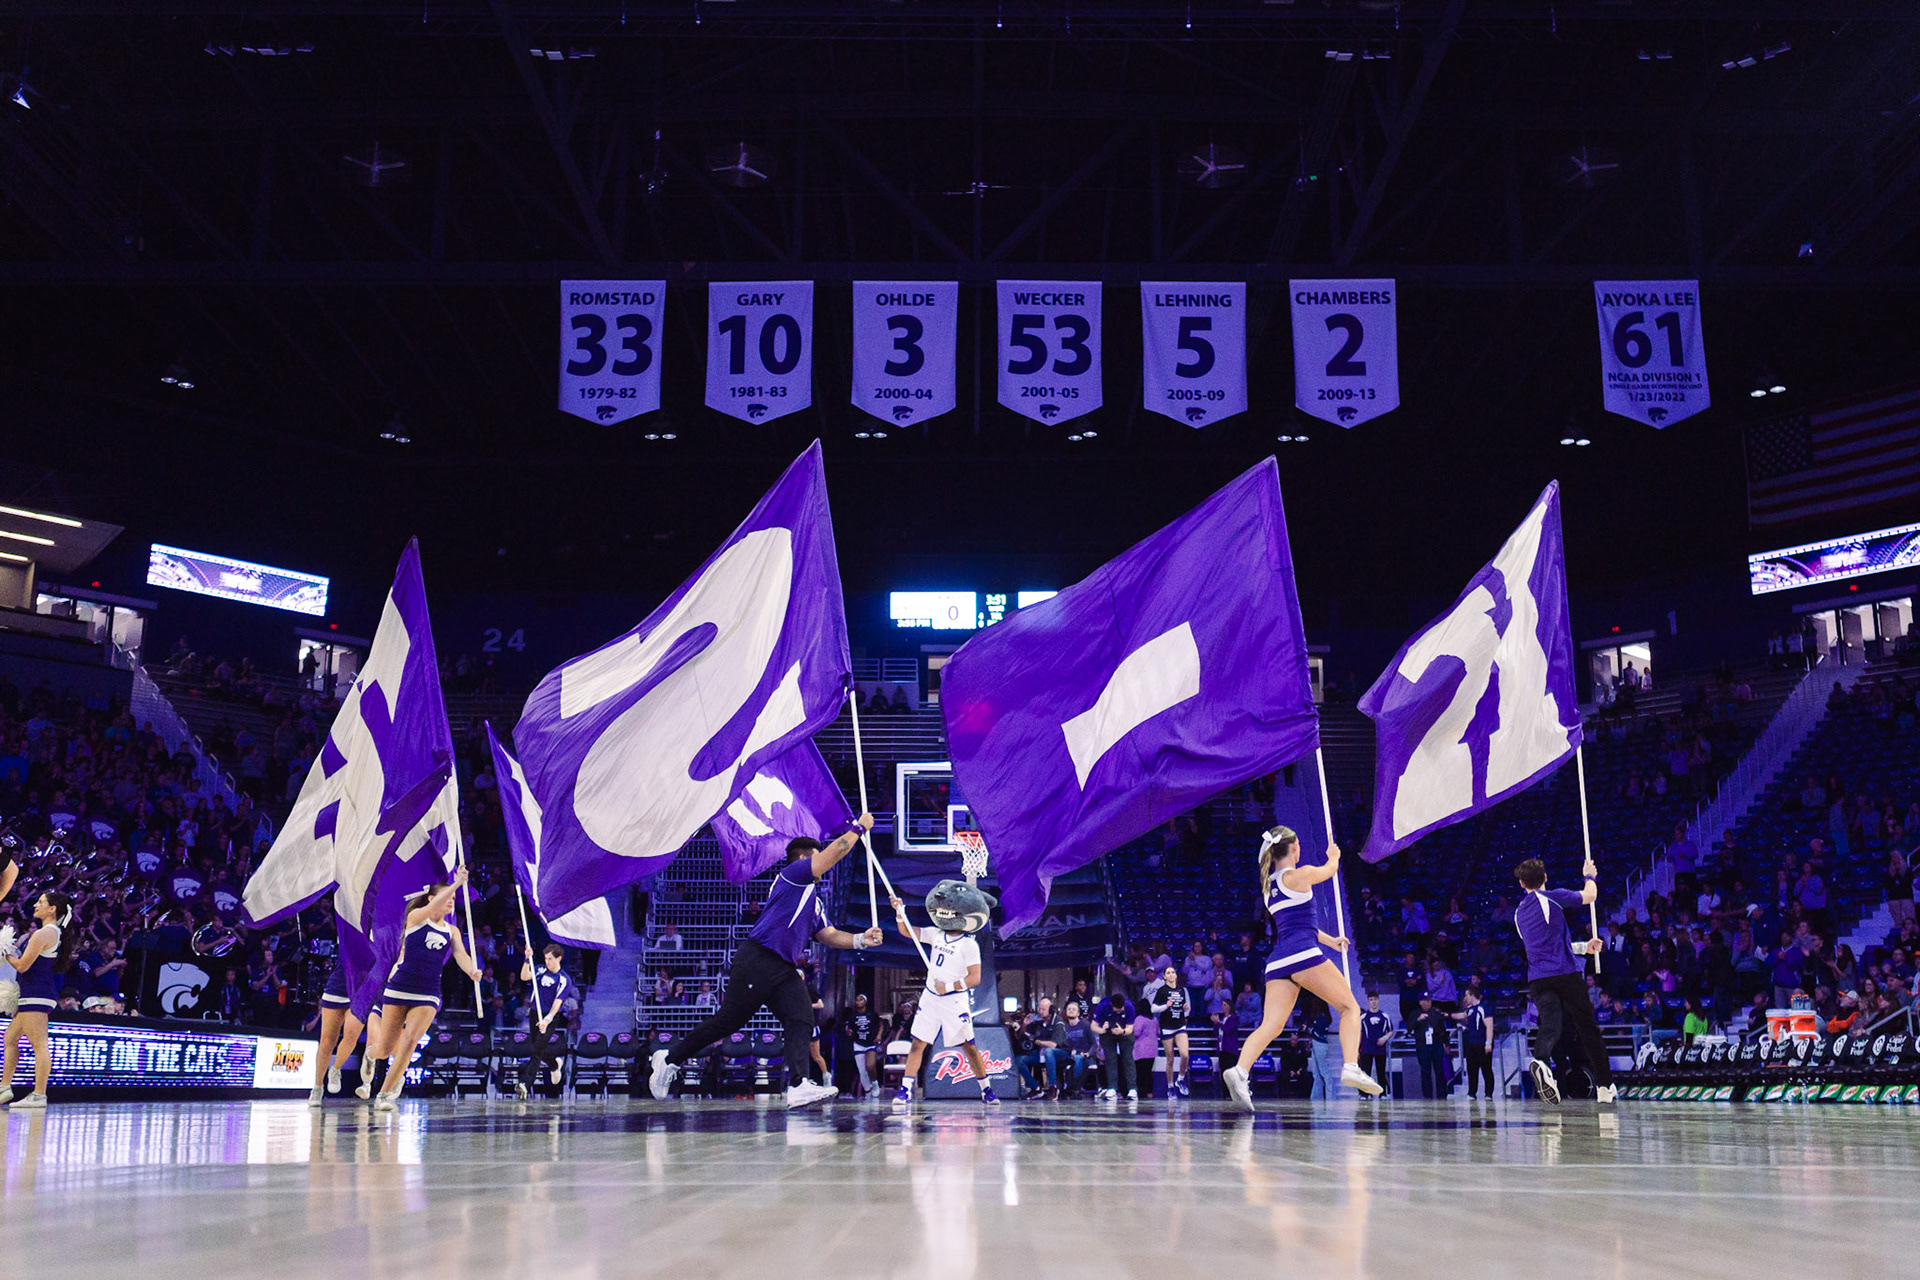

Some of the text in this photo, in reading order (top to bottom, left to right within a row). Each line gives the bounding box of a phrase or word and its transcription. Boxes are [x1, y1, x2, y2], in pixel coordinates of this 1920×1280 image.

[570, 293, 655, 306] ROMSTAD
[737, 293, 784, 306] GARY
[876, 293, 935, 306] OHLDE
[1014, 293, 1085, 306] WECKER
[1156, 294, 1232, 307] LEHNING
[1295, 292, 1391, 305] CHAMBERS
[1603, 293, 1694, 306] AYOKA LEE
[566, 314, 653, 376] 33
[718, 314, 802, 375] 10
[884, 314, 925, 376] 3
[1007, 314, 1092, 376] 53
[1324, 314, 1367, 376] 2
[1613, 312, 1684, 368] 61
[1175, 317, 1215, 378] 5
[1608, 373, 1639, 382] NCAA
[1643, 373, 1691, 382] DIVISION
[579, 388, 637, 399] 1979-82
[730, 386, 787, 398] 1981-83
[874, 388, 933, 400] 2000-04
[1021, 387, 1079, 399] 2001-05
[1167, 389, 1225, 401] 2005-09
[1318, 389, 1376, 400] 2009-13
[1628, 392, 1685, 402] 1/23/2022
[482, 628, 526, 652] 24
[936, 953, 945, 967] 0
[111, 1041, 141, 1071] ON
[146, 1043, 182, 1072] THE
[184, 1044, 227, 1073] CATS
